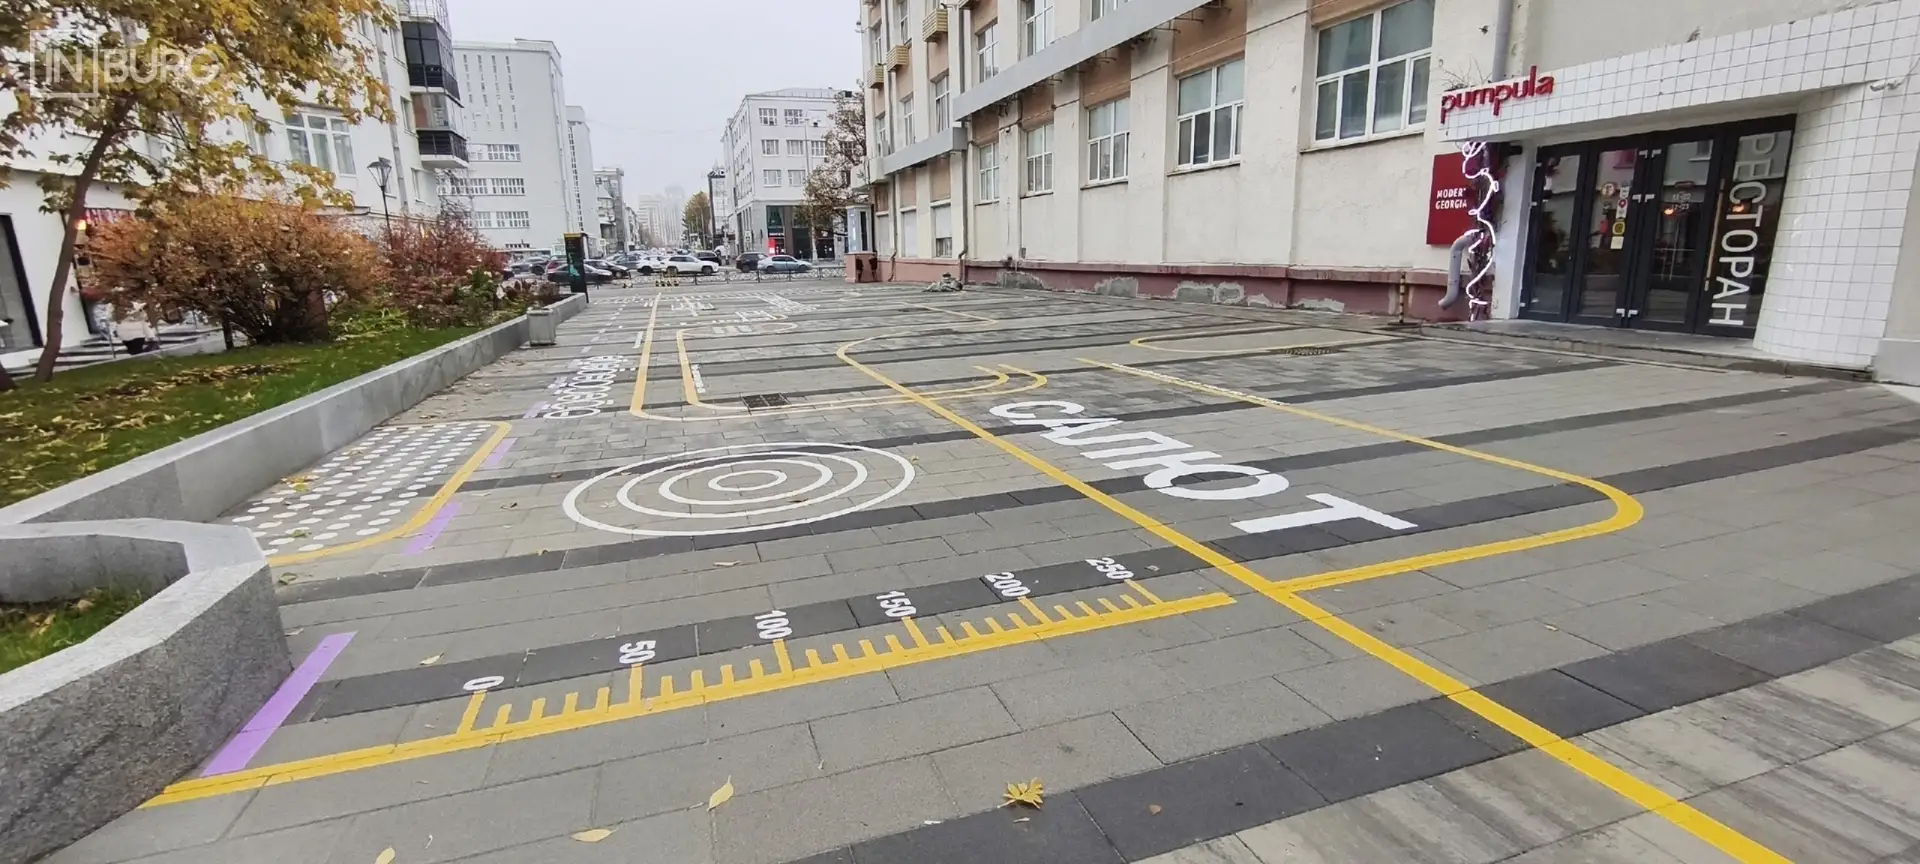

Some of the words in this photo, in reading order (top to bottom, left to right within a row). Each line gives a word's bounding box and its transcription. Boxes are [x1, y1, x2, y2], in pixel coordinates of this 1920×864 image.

[1440, 65, 1554, 125] pumpula
[1435, 199, 1467, 210] GEORGIA
[1436, 187, 1467, 199] MODER
[1708, 132, 1777, 326] РЕСТОРАН
[988, 400, 1418, 534] САЛЮТ
[1085, 556, 1135, 580] 250
[985, 571, 1032, 598] 200
[876, 590, 917, 618] 150
[753, 610, 793, 640] 100
[618, 640, 656, 664] 50
[463, 675, 505, 691] 0
